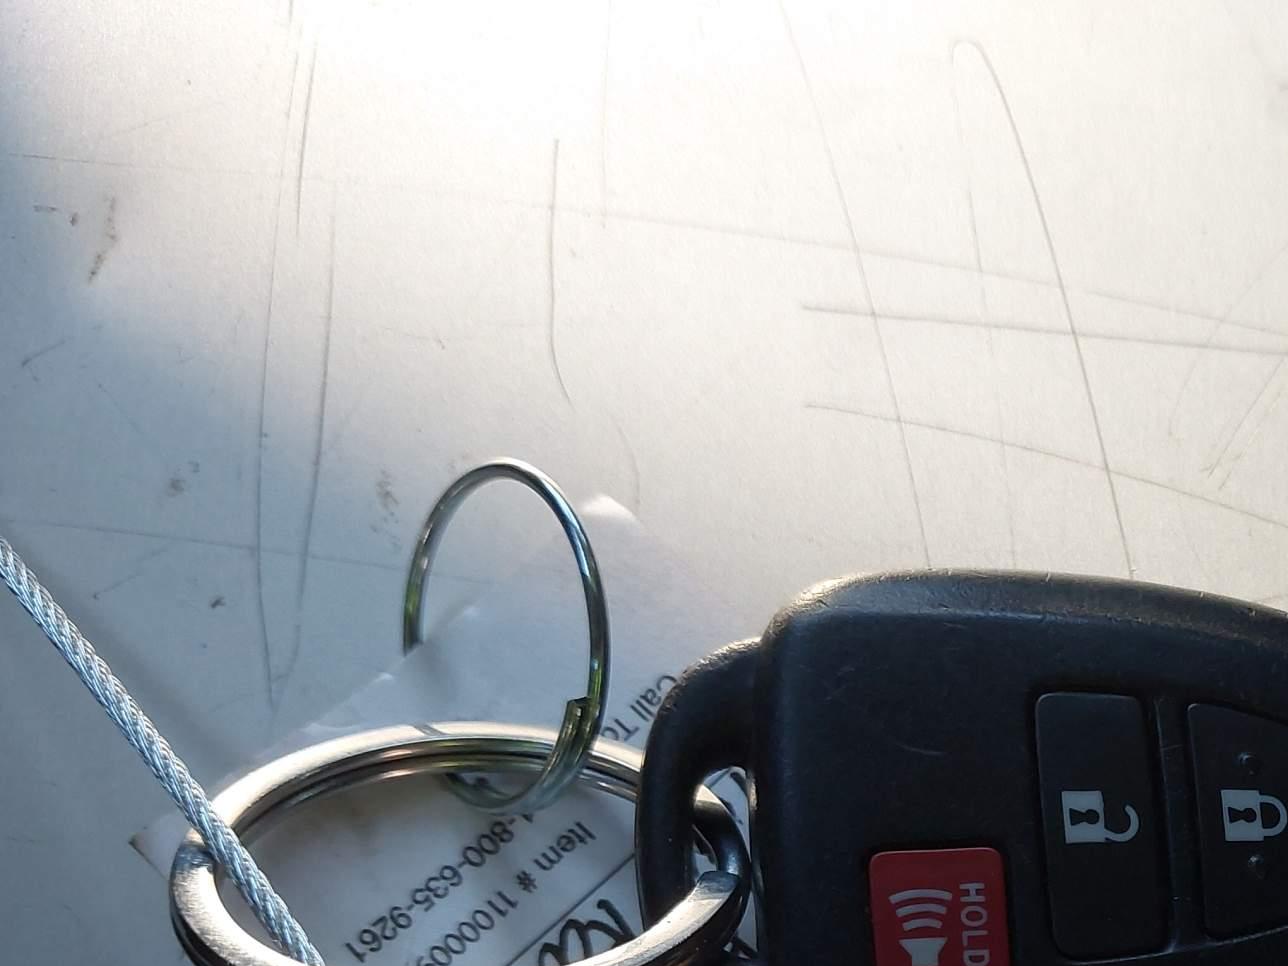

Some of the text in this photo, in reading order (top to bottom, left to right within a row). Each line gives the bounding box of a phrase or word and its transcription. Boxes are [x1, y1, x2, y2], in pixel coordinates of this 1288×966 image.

[630, 675, 678, 722] Call
[533, 821, 597, 871] Item
[514, 869, 539, 893] #
